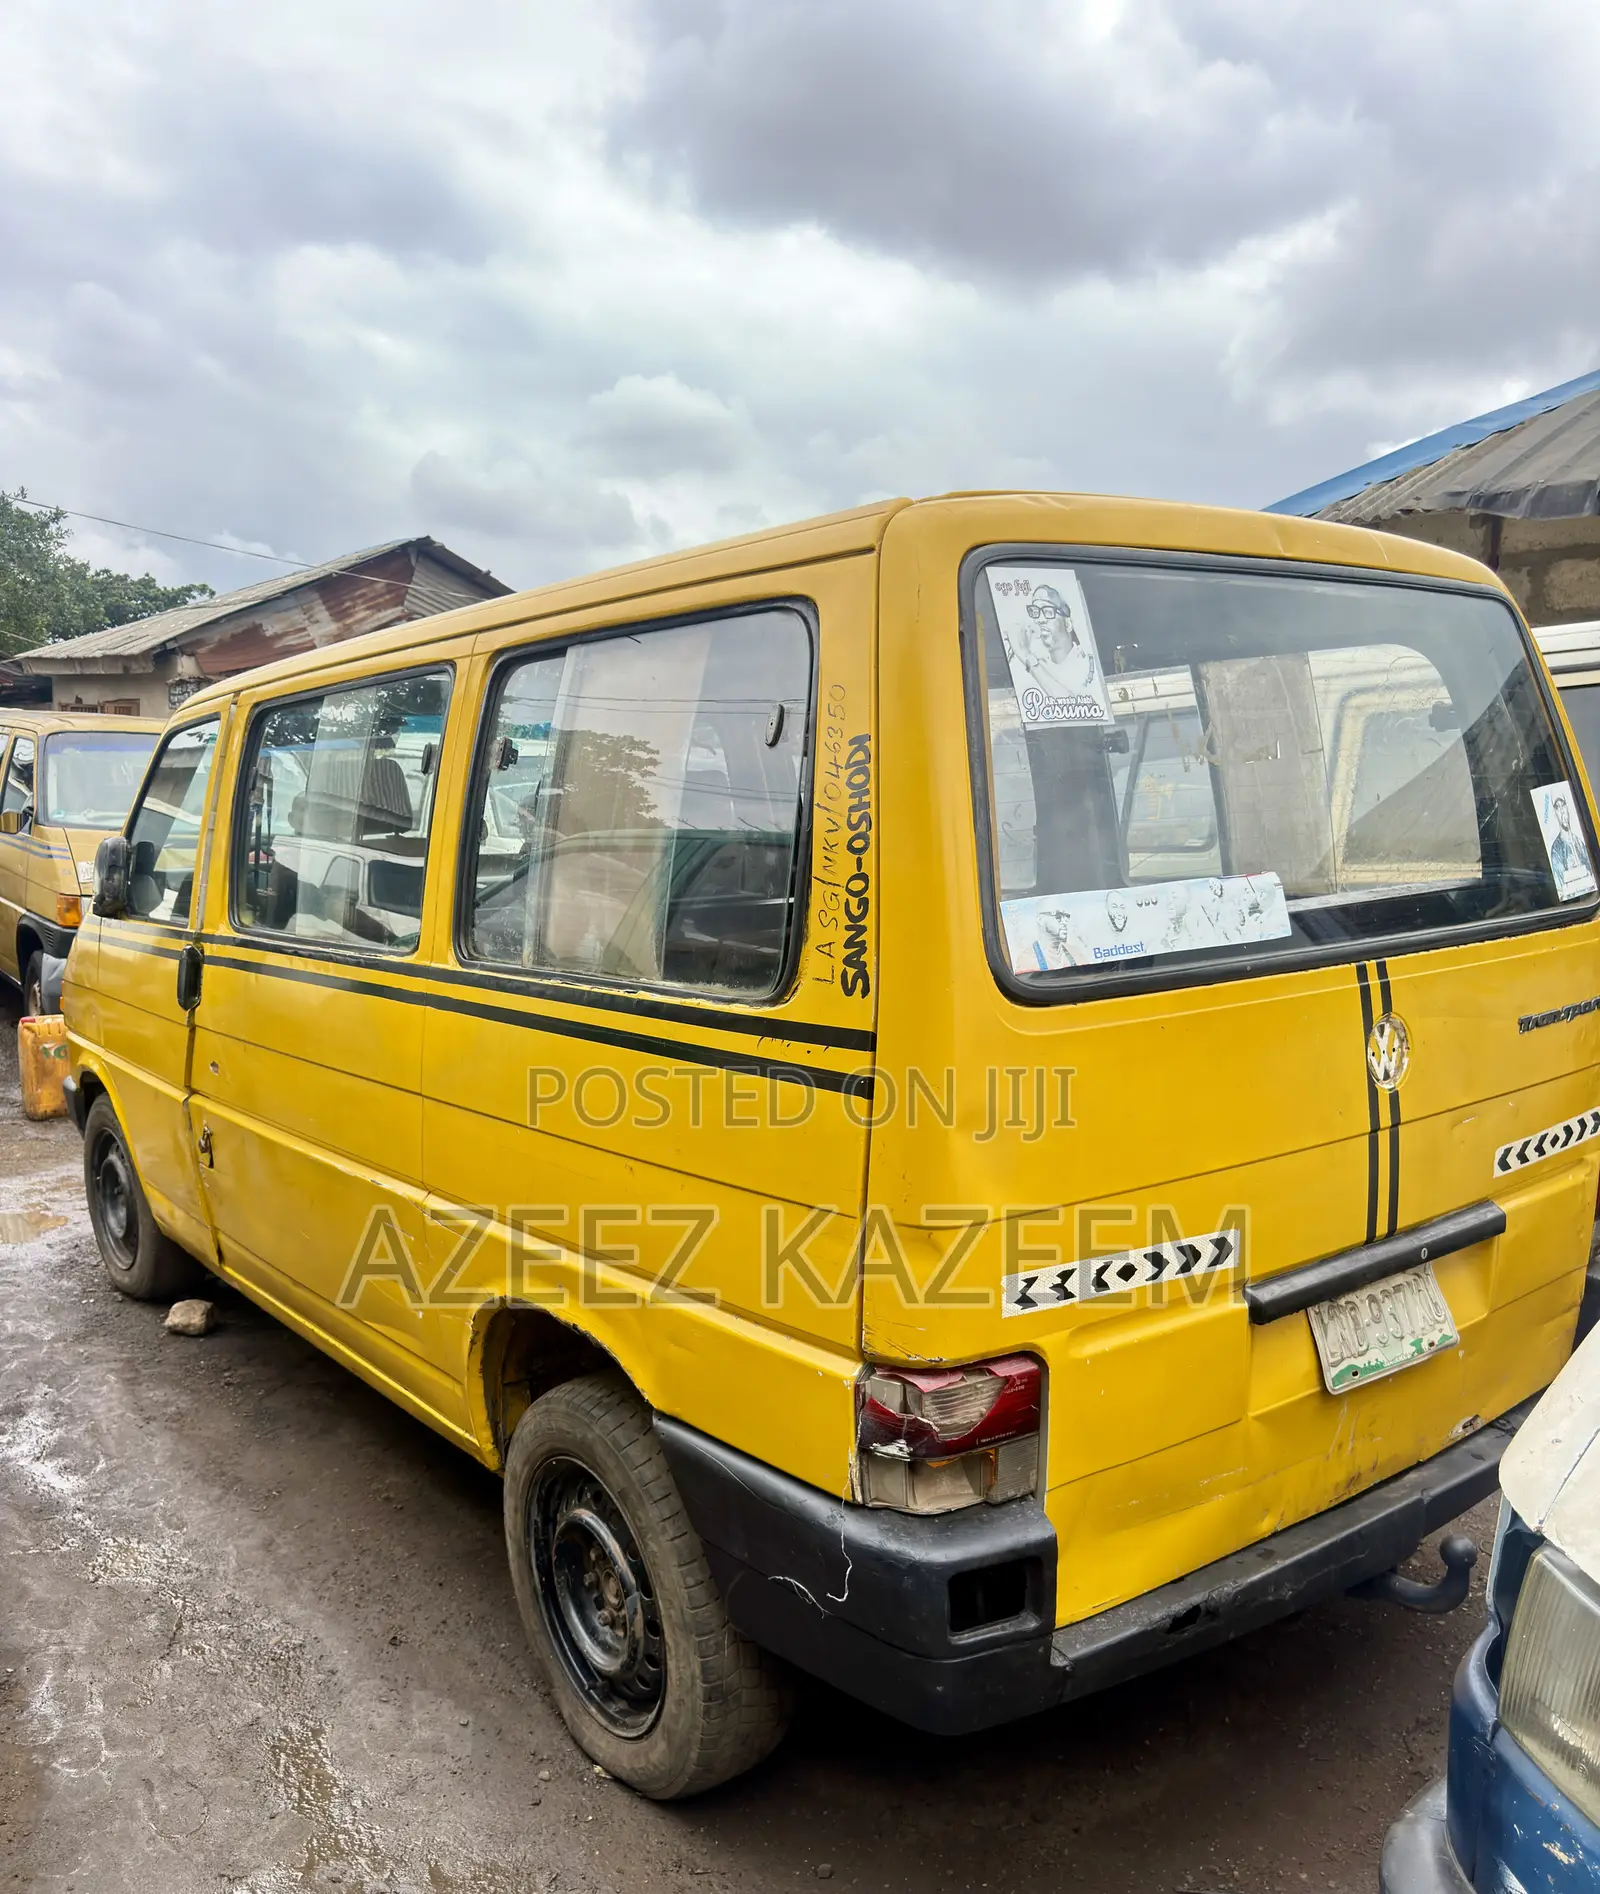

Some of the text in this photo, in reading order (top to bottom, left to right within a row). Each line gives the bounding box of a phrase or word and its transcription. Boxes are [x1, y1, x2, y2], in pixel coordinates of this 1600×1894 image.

[1022, 687, 1104, 720] Pasuma
[840, 733, 872, 999] SANGO-OSHODI
[1093, 941, 1144, 959] Baddest
